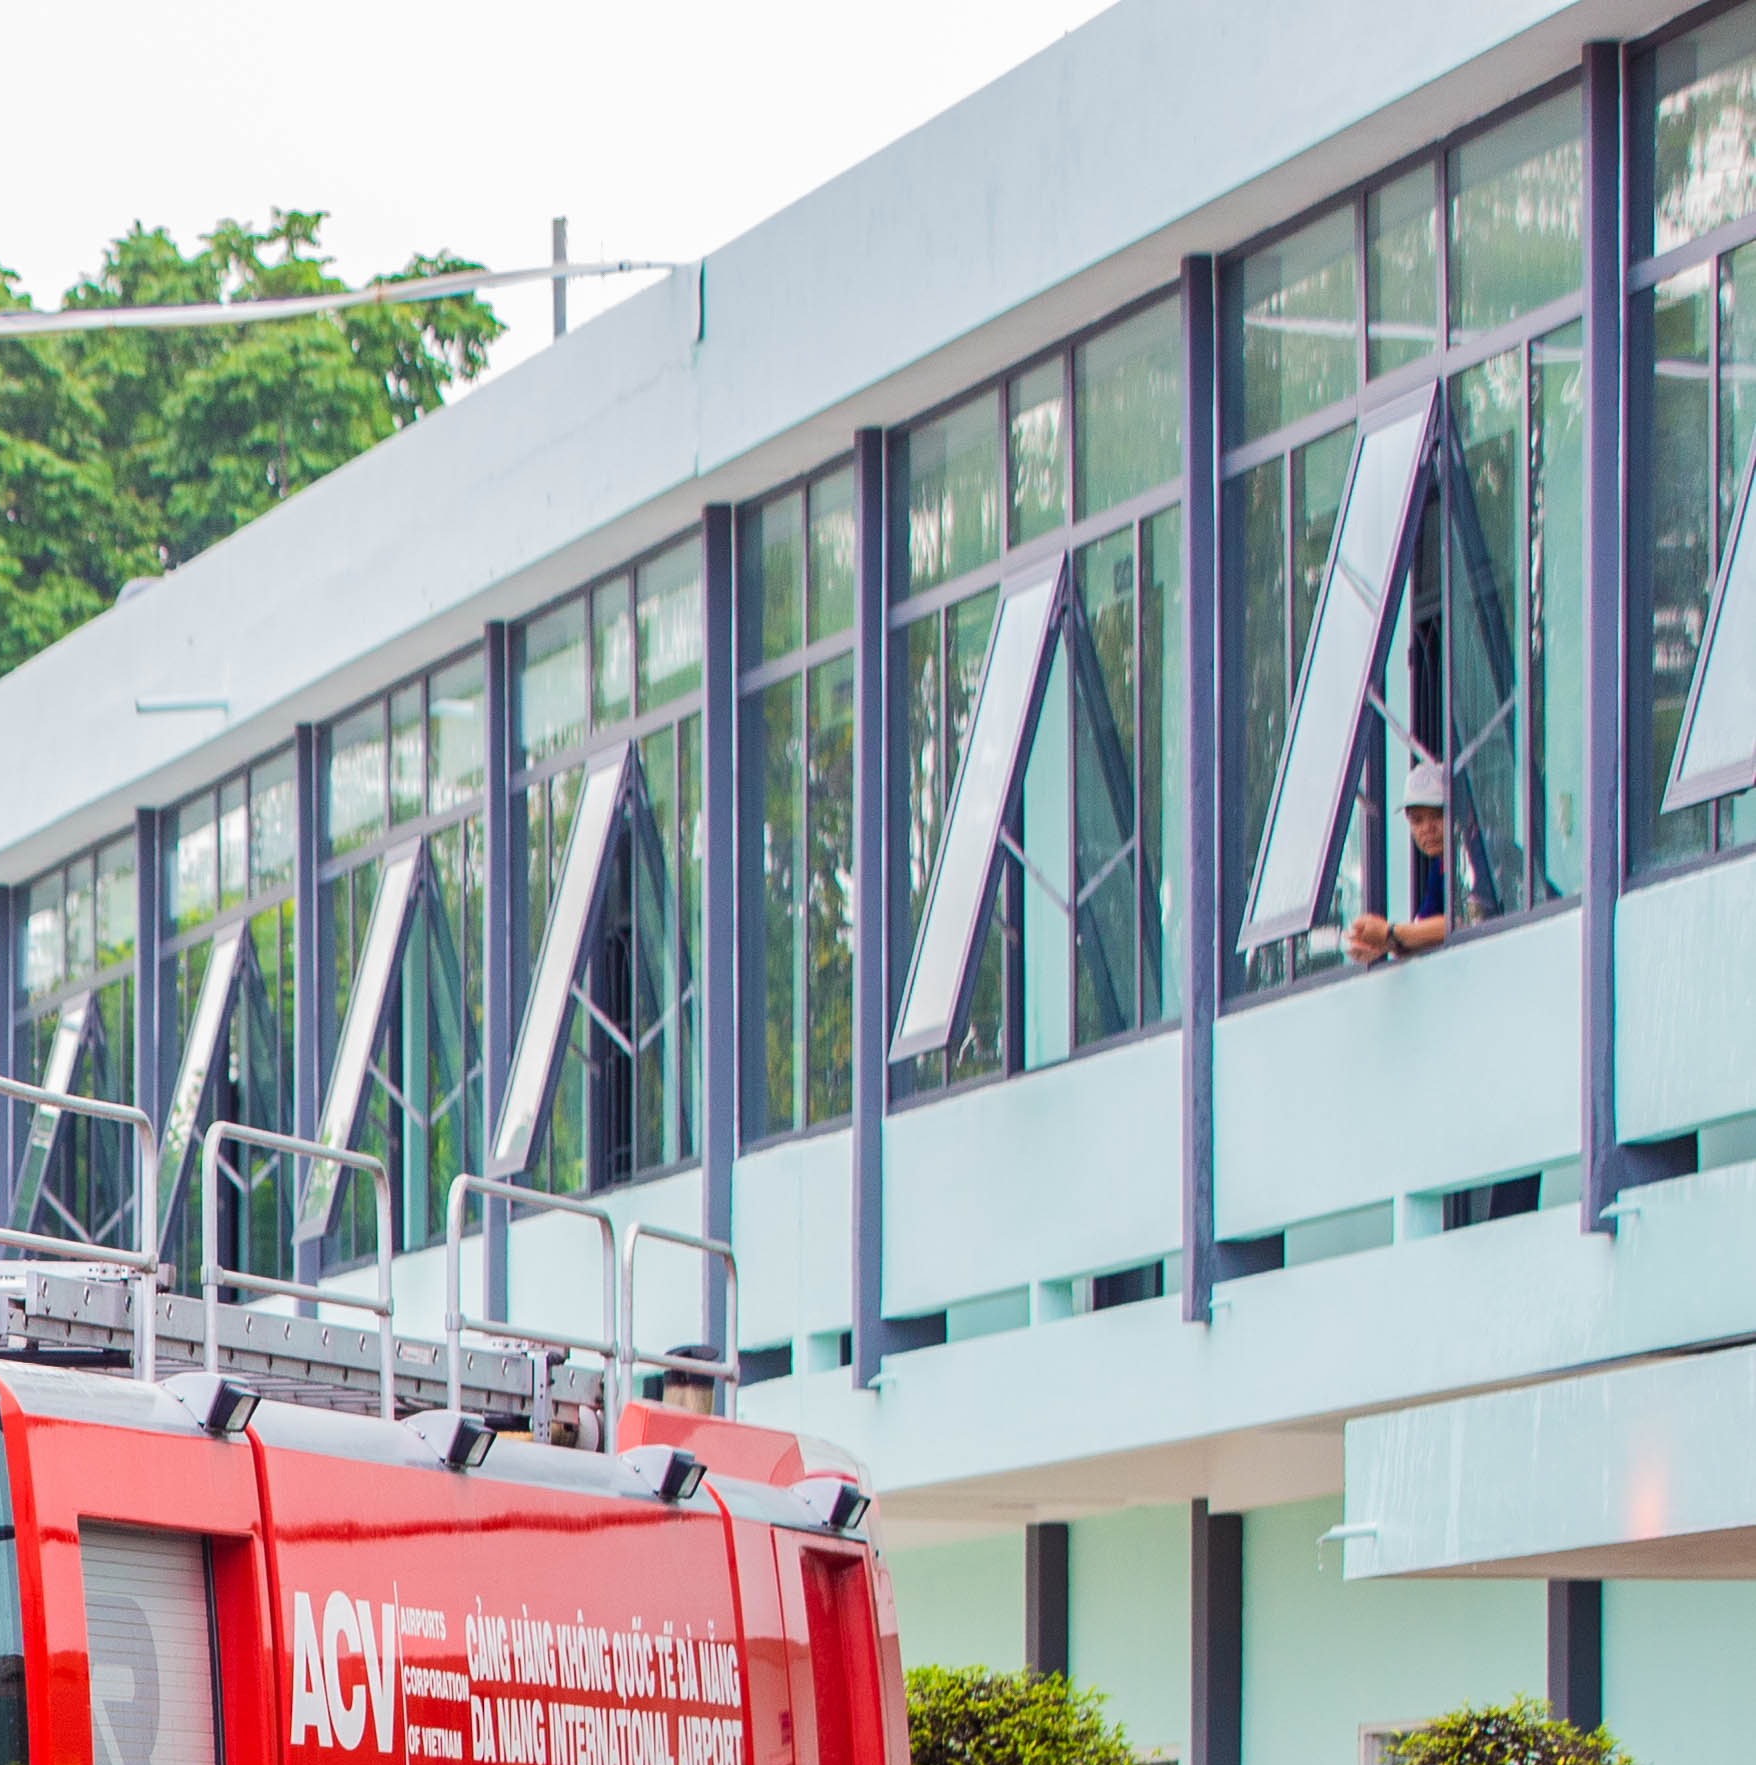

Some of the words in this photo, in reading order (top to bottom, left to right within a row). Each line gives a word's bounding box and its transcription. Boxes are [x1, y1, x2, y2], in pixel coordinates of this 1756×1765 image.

[400, 1606, 446, 1641] AIRPORTS
[290, 1590, 396, 1753] ACV
[464, 1594, 512, 1684] CẢNG
[510, 1603, 557, 1688] HÀNG
[556, 1608, 612, 1693] KHÔNG
[612, 1615, 655, 1707] QUỐC
[654, 1620, 676, 1699] TẾ
[676, 1623, 699, 1702] ĐÀ
[698, 1618, 741, 1708] NẴNG
[403, 1665, 470, 1703] CORPORATION
[407, 1724, 421, 1756] OF
[421, 1726, 463, 1760] VIETNAM
[470, 1694, 497, 1763] DA
